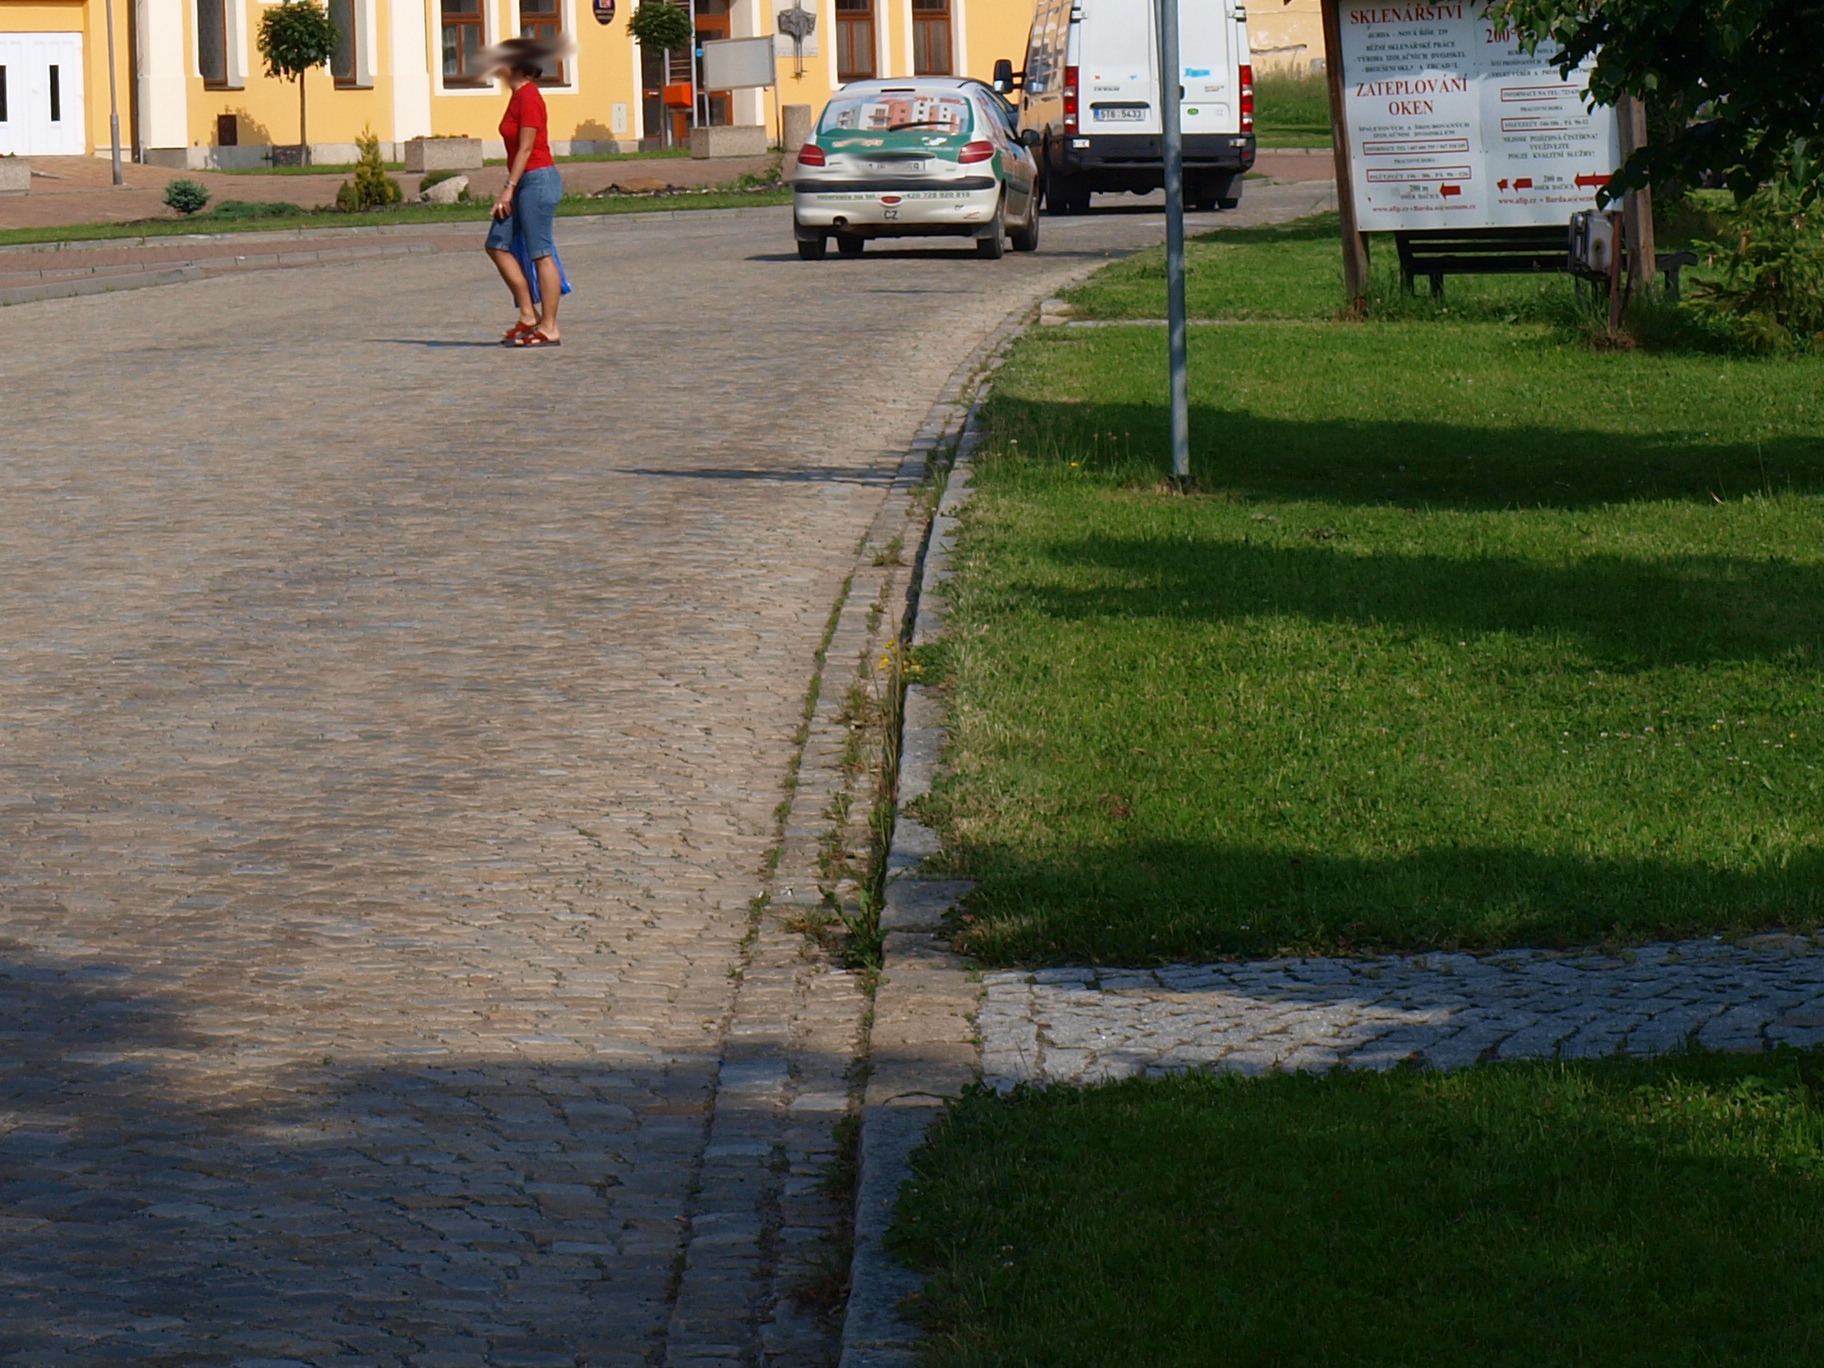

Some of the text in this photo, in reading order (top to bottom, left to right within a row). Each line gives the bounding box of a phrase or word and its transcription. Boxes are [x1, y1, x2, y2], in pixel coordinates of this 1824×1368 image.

[1350, 0, 1463, 25] SKLENÁŘSTVÍ
[1356, 73, 1468, 97] ZATEPLOVÁNÍ
[1388, 99, 1434, 116] OKEN
[883, 209, 899, 221] CZ
